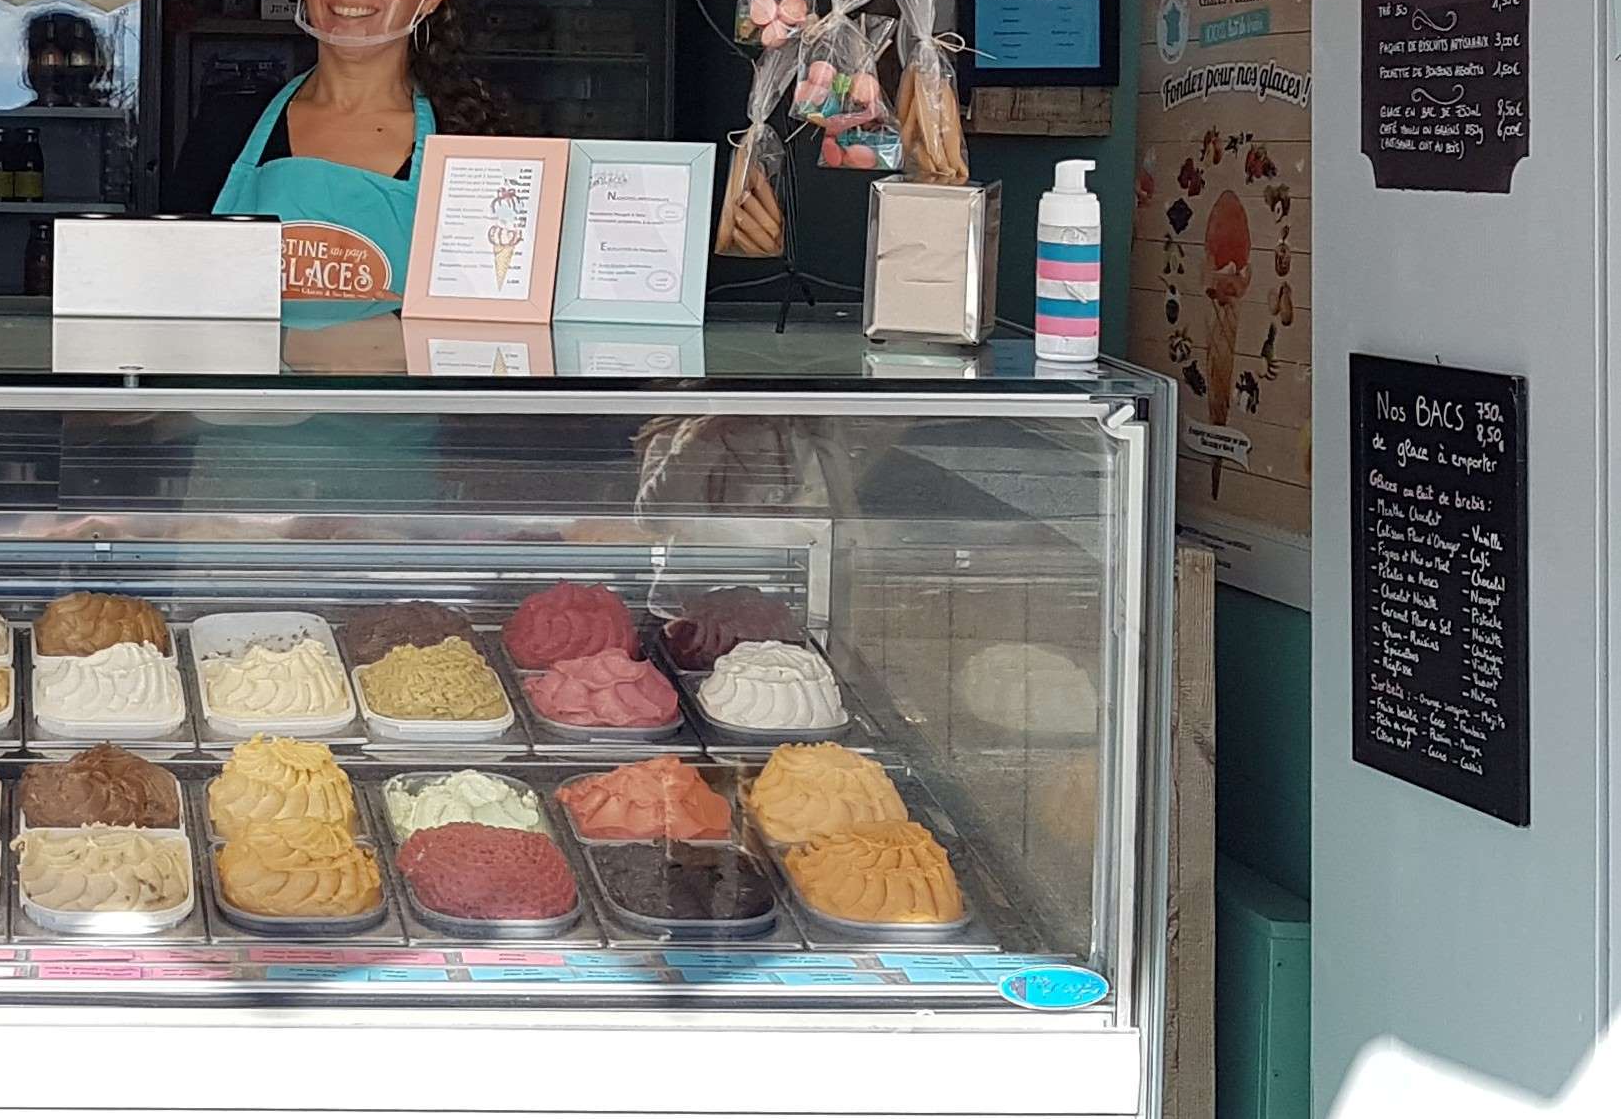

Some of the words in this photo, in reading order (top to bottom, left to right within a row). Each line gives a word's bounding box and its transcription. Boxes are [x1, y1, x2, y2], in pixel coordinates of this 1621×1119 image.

[1163, 69, 1203, 105] Fondez
[1204, 65, 1234, 95] pour
[1236, 63, 1258, 84] nos
[1377, 390, 1406, 422] Nos
[1416, 395, 1464, 431] BACS
[1373, 433, 1386, 450] de
[1398, 439, 1429, 467] glace
[1438, 444, 1447, 464] à
[1451, 454, 1497, 475] emporter
